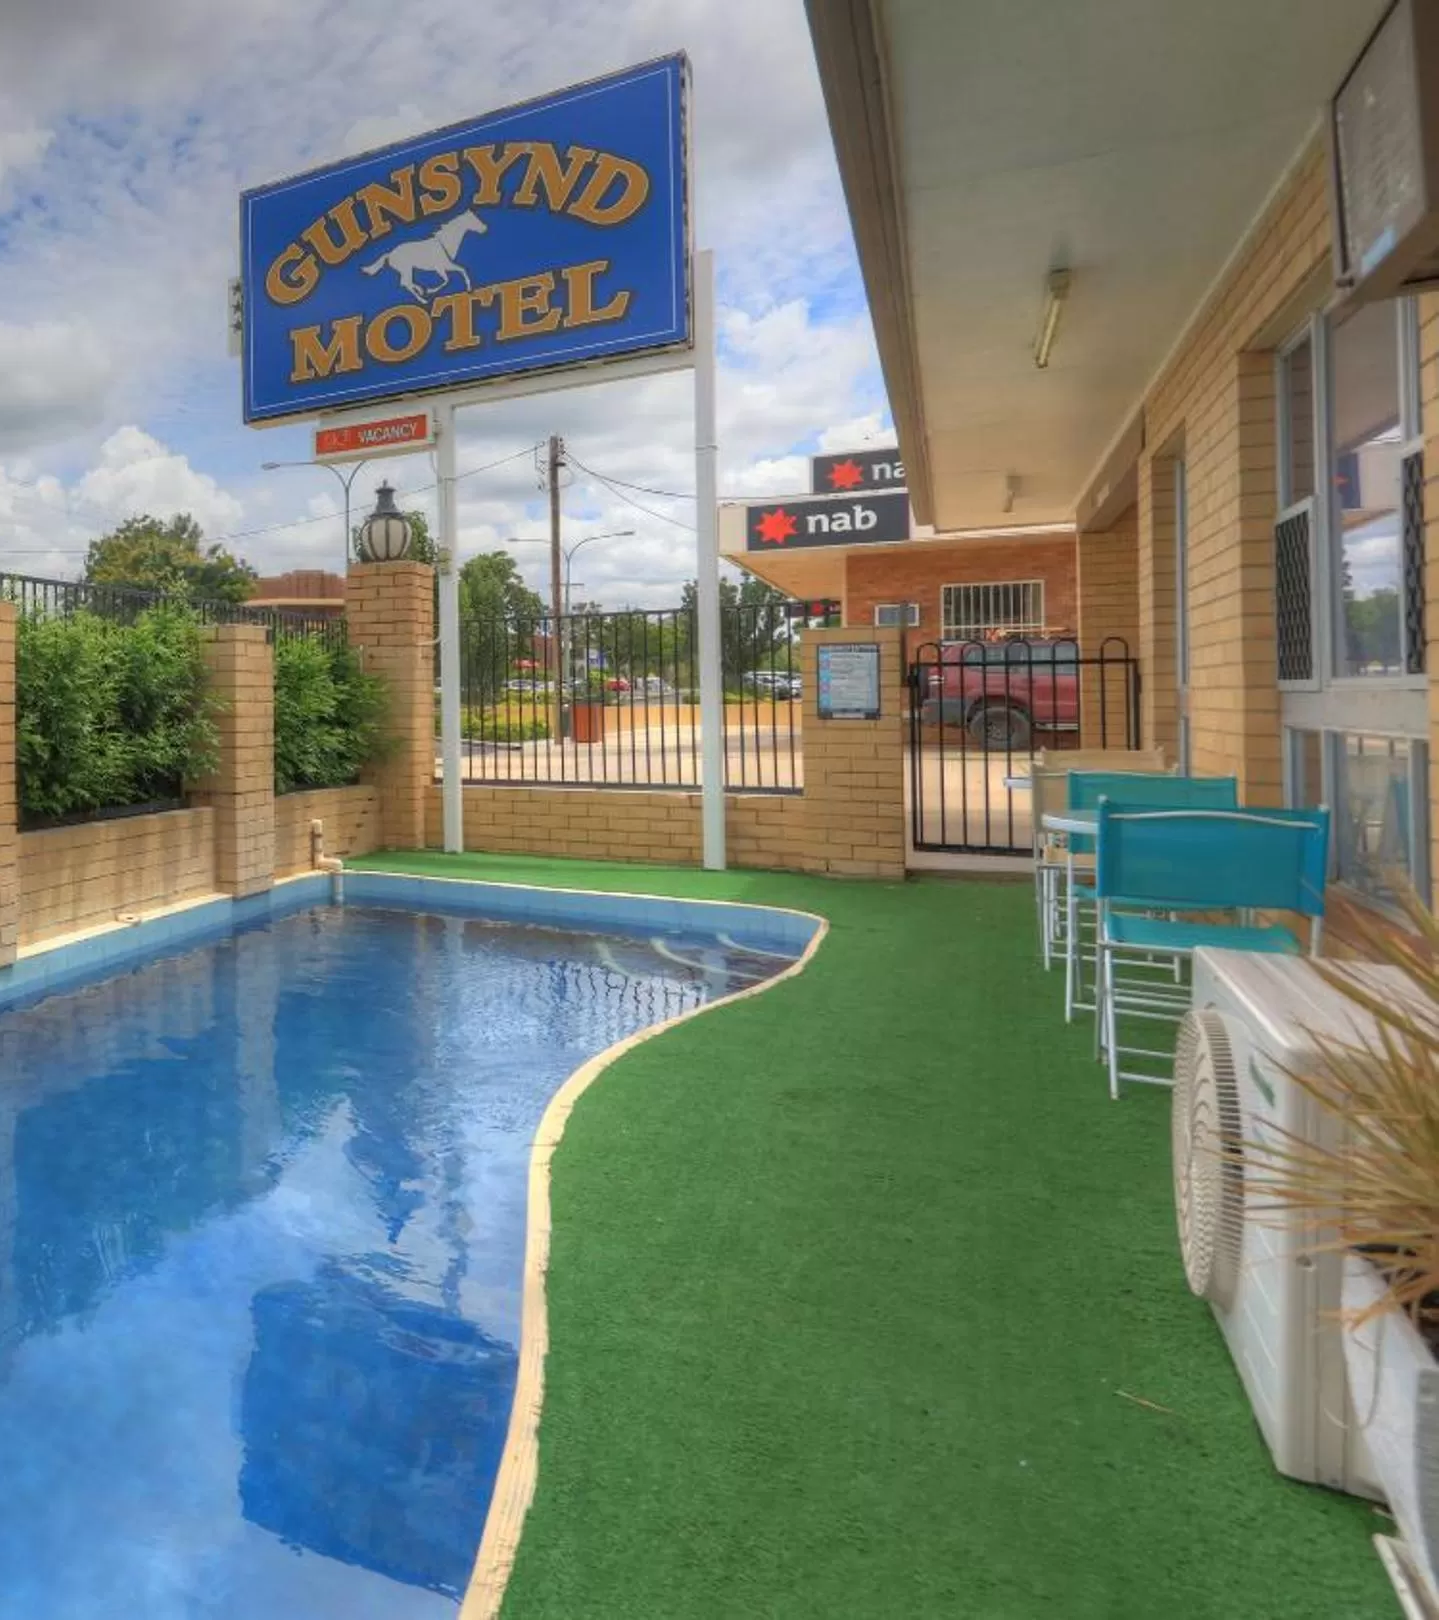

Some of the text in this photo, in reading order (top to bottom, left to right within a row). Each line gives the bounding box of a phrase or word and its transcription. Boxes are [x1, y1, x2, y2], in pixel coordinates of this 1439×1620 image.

[265, 141, 650, 305] GUNSYND
[290, 260, 630, 383] MOTEL
[358, 422, 418, 444] VACANCY
[871, 461, 907, 481] na
[806, 504, 878, 534] nab
